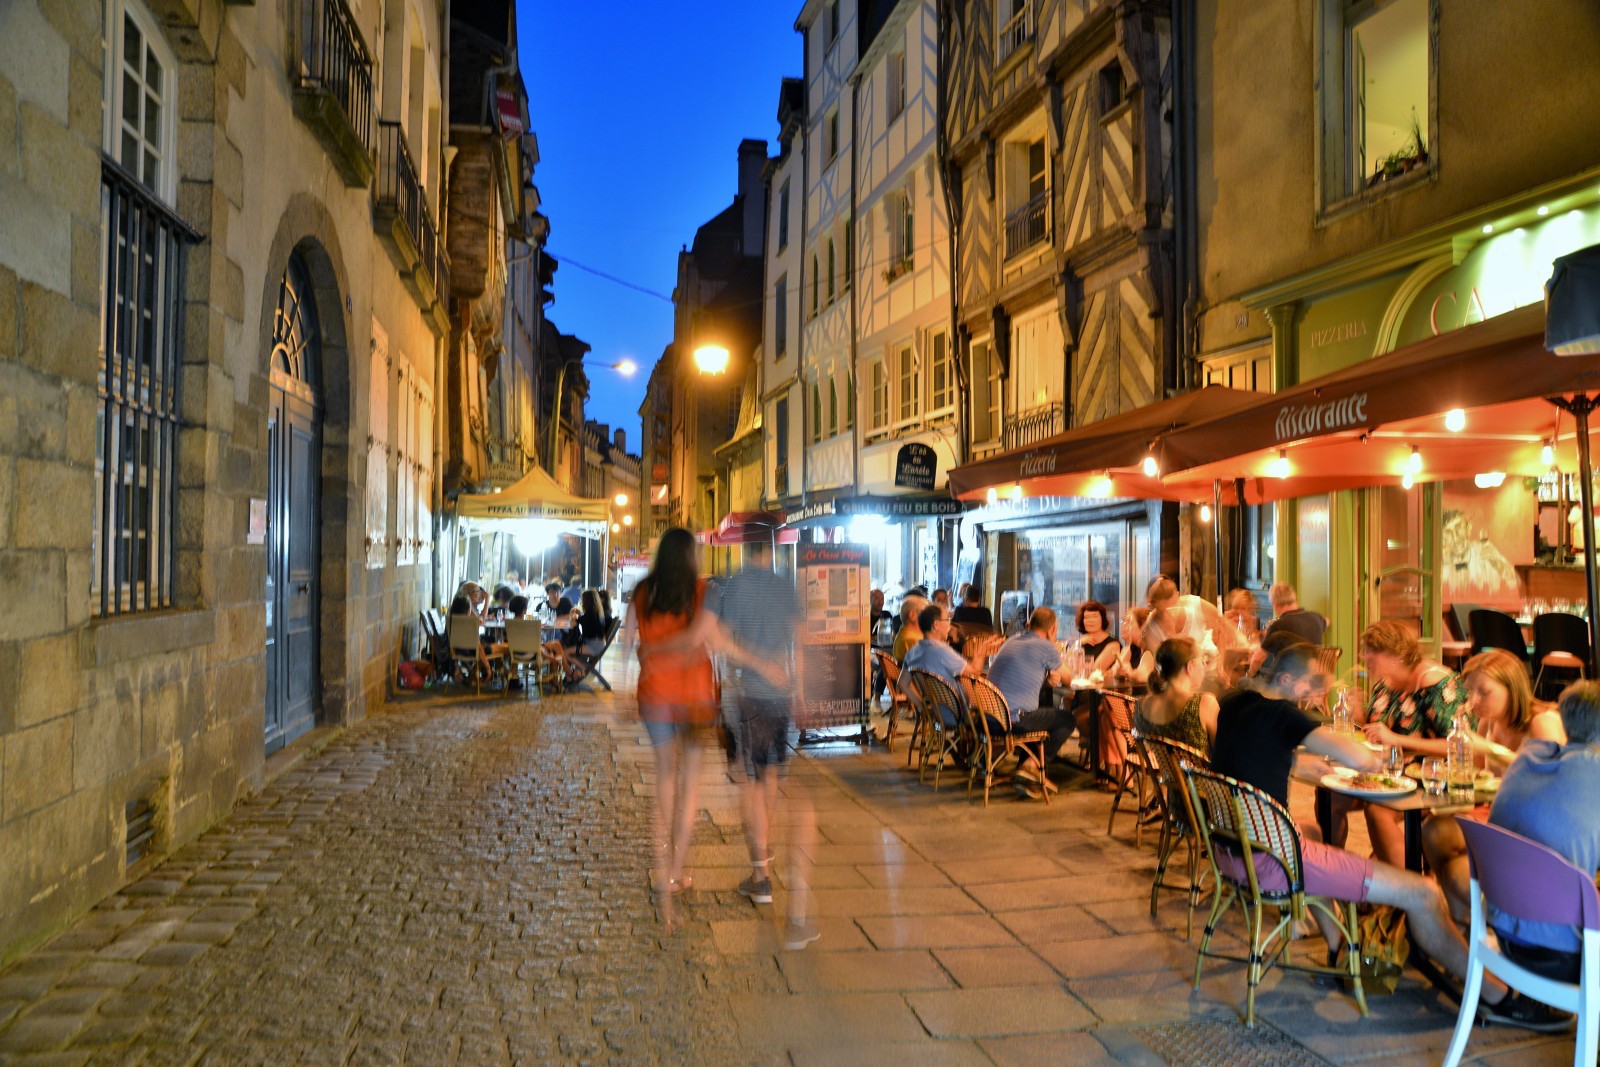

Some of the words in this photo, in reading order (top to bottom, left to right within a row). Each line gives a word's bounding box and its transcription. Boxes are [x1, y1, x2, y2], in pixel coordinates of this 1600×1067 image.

[1310, 320, 1368, 348] PIZZERIA
[1275, 392, 1368, 440] Ristorante
[487, 505, 513, 514] PIZZA
[515, 506, 527, 514] AU
[842, 502, 871, 514] GRILL
[875, 502, 890, 514] AU
[892, 502, 912, 514] FEU
[915, 502, 928, 514] DE
[931, 501, 957, 513] BOIS
[1039, 495, 1062, 512] DU
